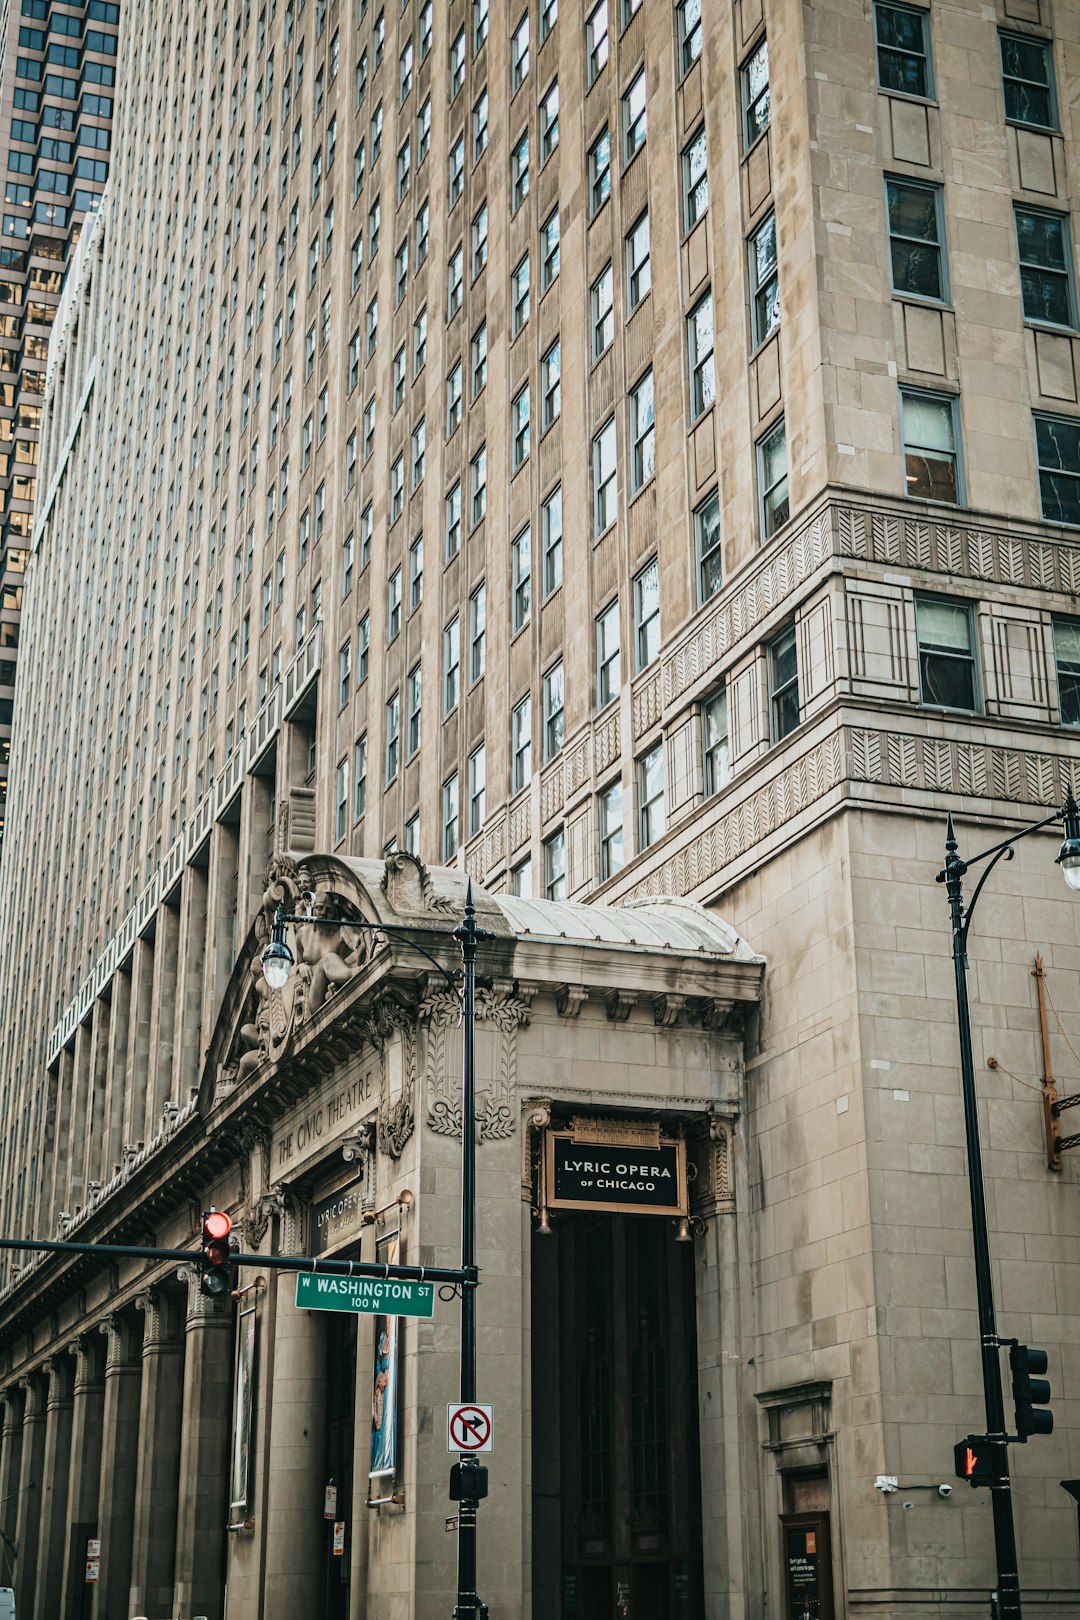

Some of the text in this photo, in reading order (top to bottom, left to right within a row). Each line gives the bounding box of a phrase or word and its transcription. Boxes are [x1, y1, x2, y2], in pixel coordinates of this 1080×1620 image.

[279, 1071, 372, 1165] THE CIVIC THEATRE
[564, 1160, 671, 1178] LYRIC OPERA
[596, 1179, 656, 1192] CHICAGO
[317, 1204, 337, 1228] LYRIC
[302, 1277, 430, 1300] W WASHINGTON ST
[351, 1297, 380, 1309] 100 N
